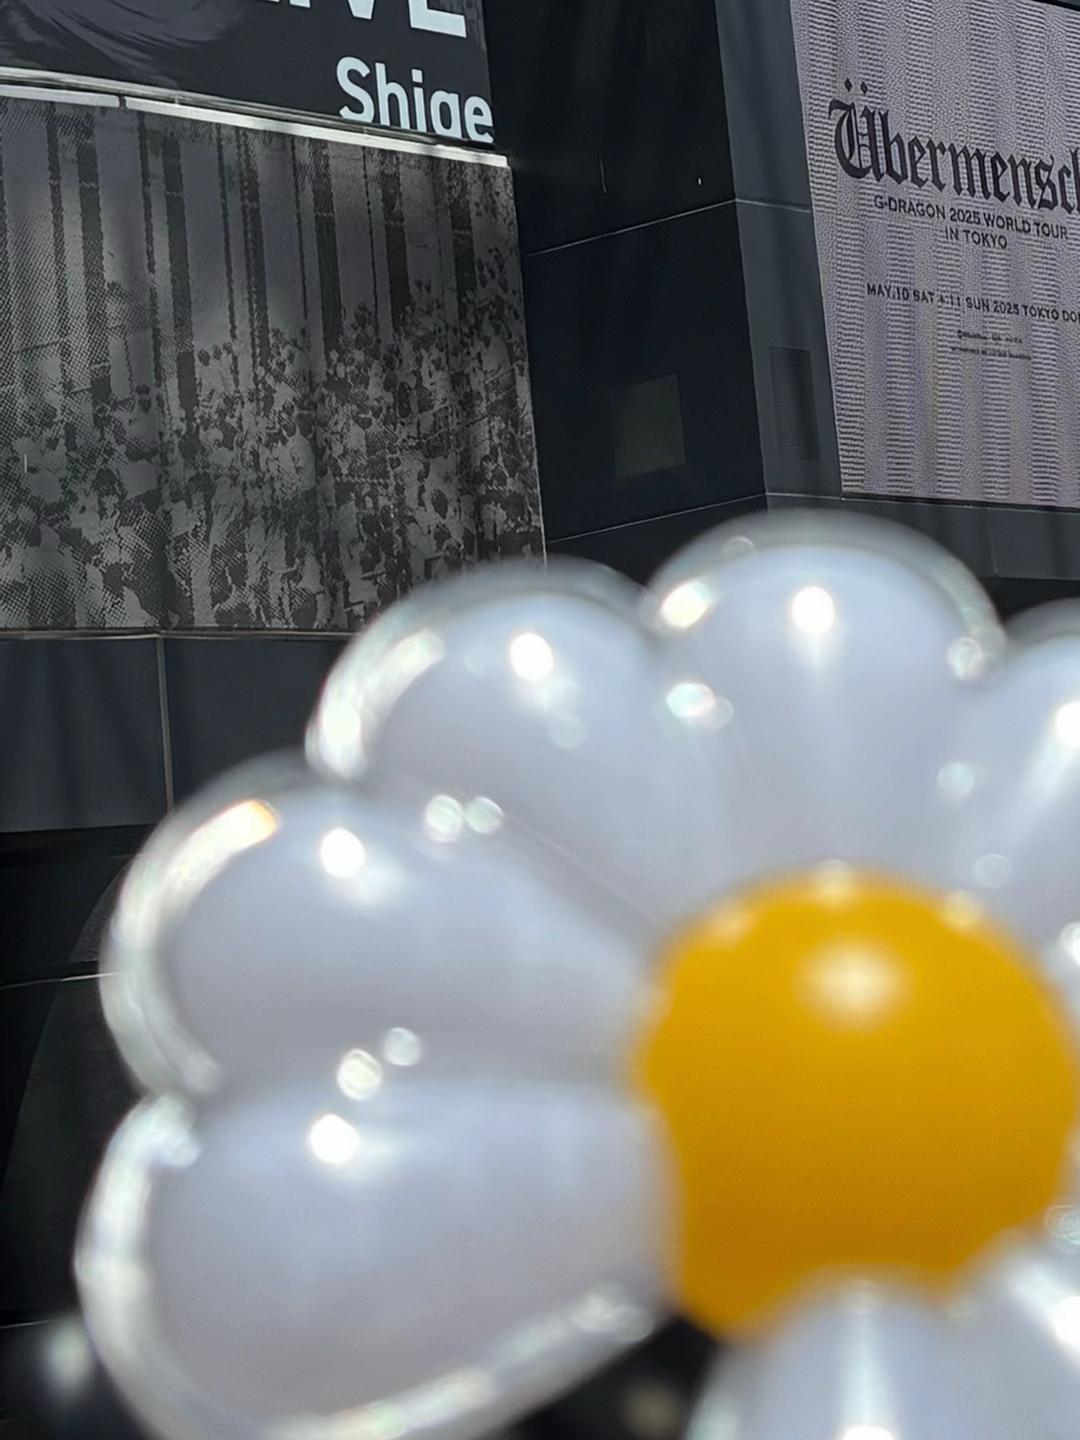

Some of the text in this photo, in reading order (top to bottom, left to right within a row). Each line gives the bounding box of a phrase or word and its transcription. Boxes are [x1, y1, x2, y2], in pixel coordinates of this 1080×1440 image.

[335, 56, 494, 144] Shige
[873, 194, 1068, 240] G-DRAGON 2025 WORLD TOUR
[945, 226, 1008, 250] IN TOKYO
[912, 289, 934, 304] SAT
[966, 296, 990, 313] SUN
[993, 300, 1019, 316] 2025
[1021, 304, 1059, 321] TOKYO
